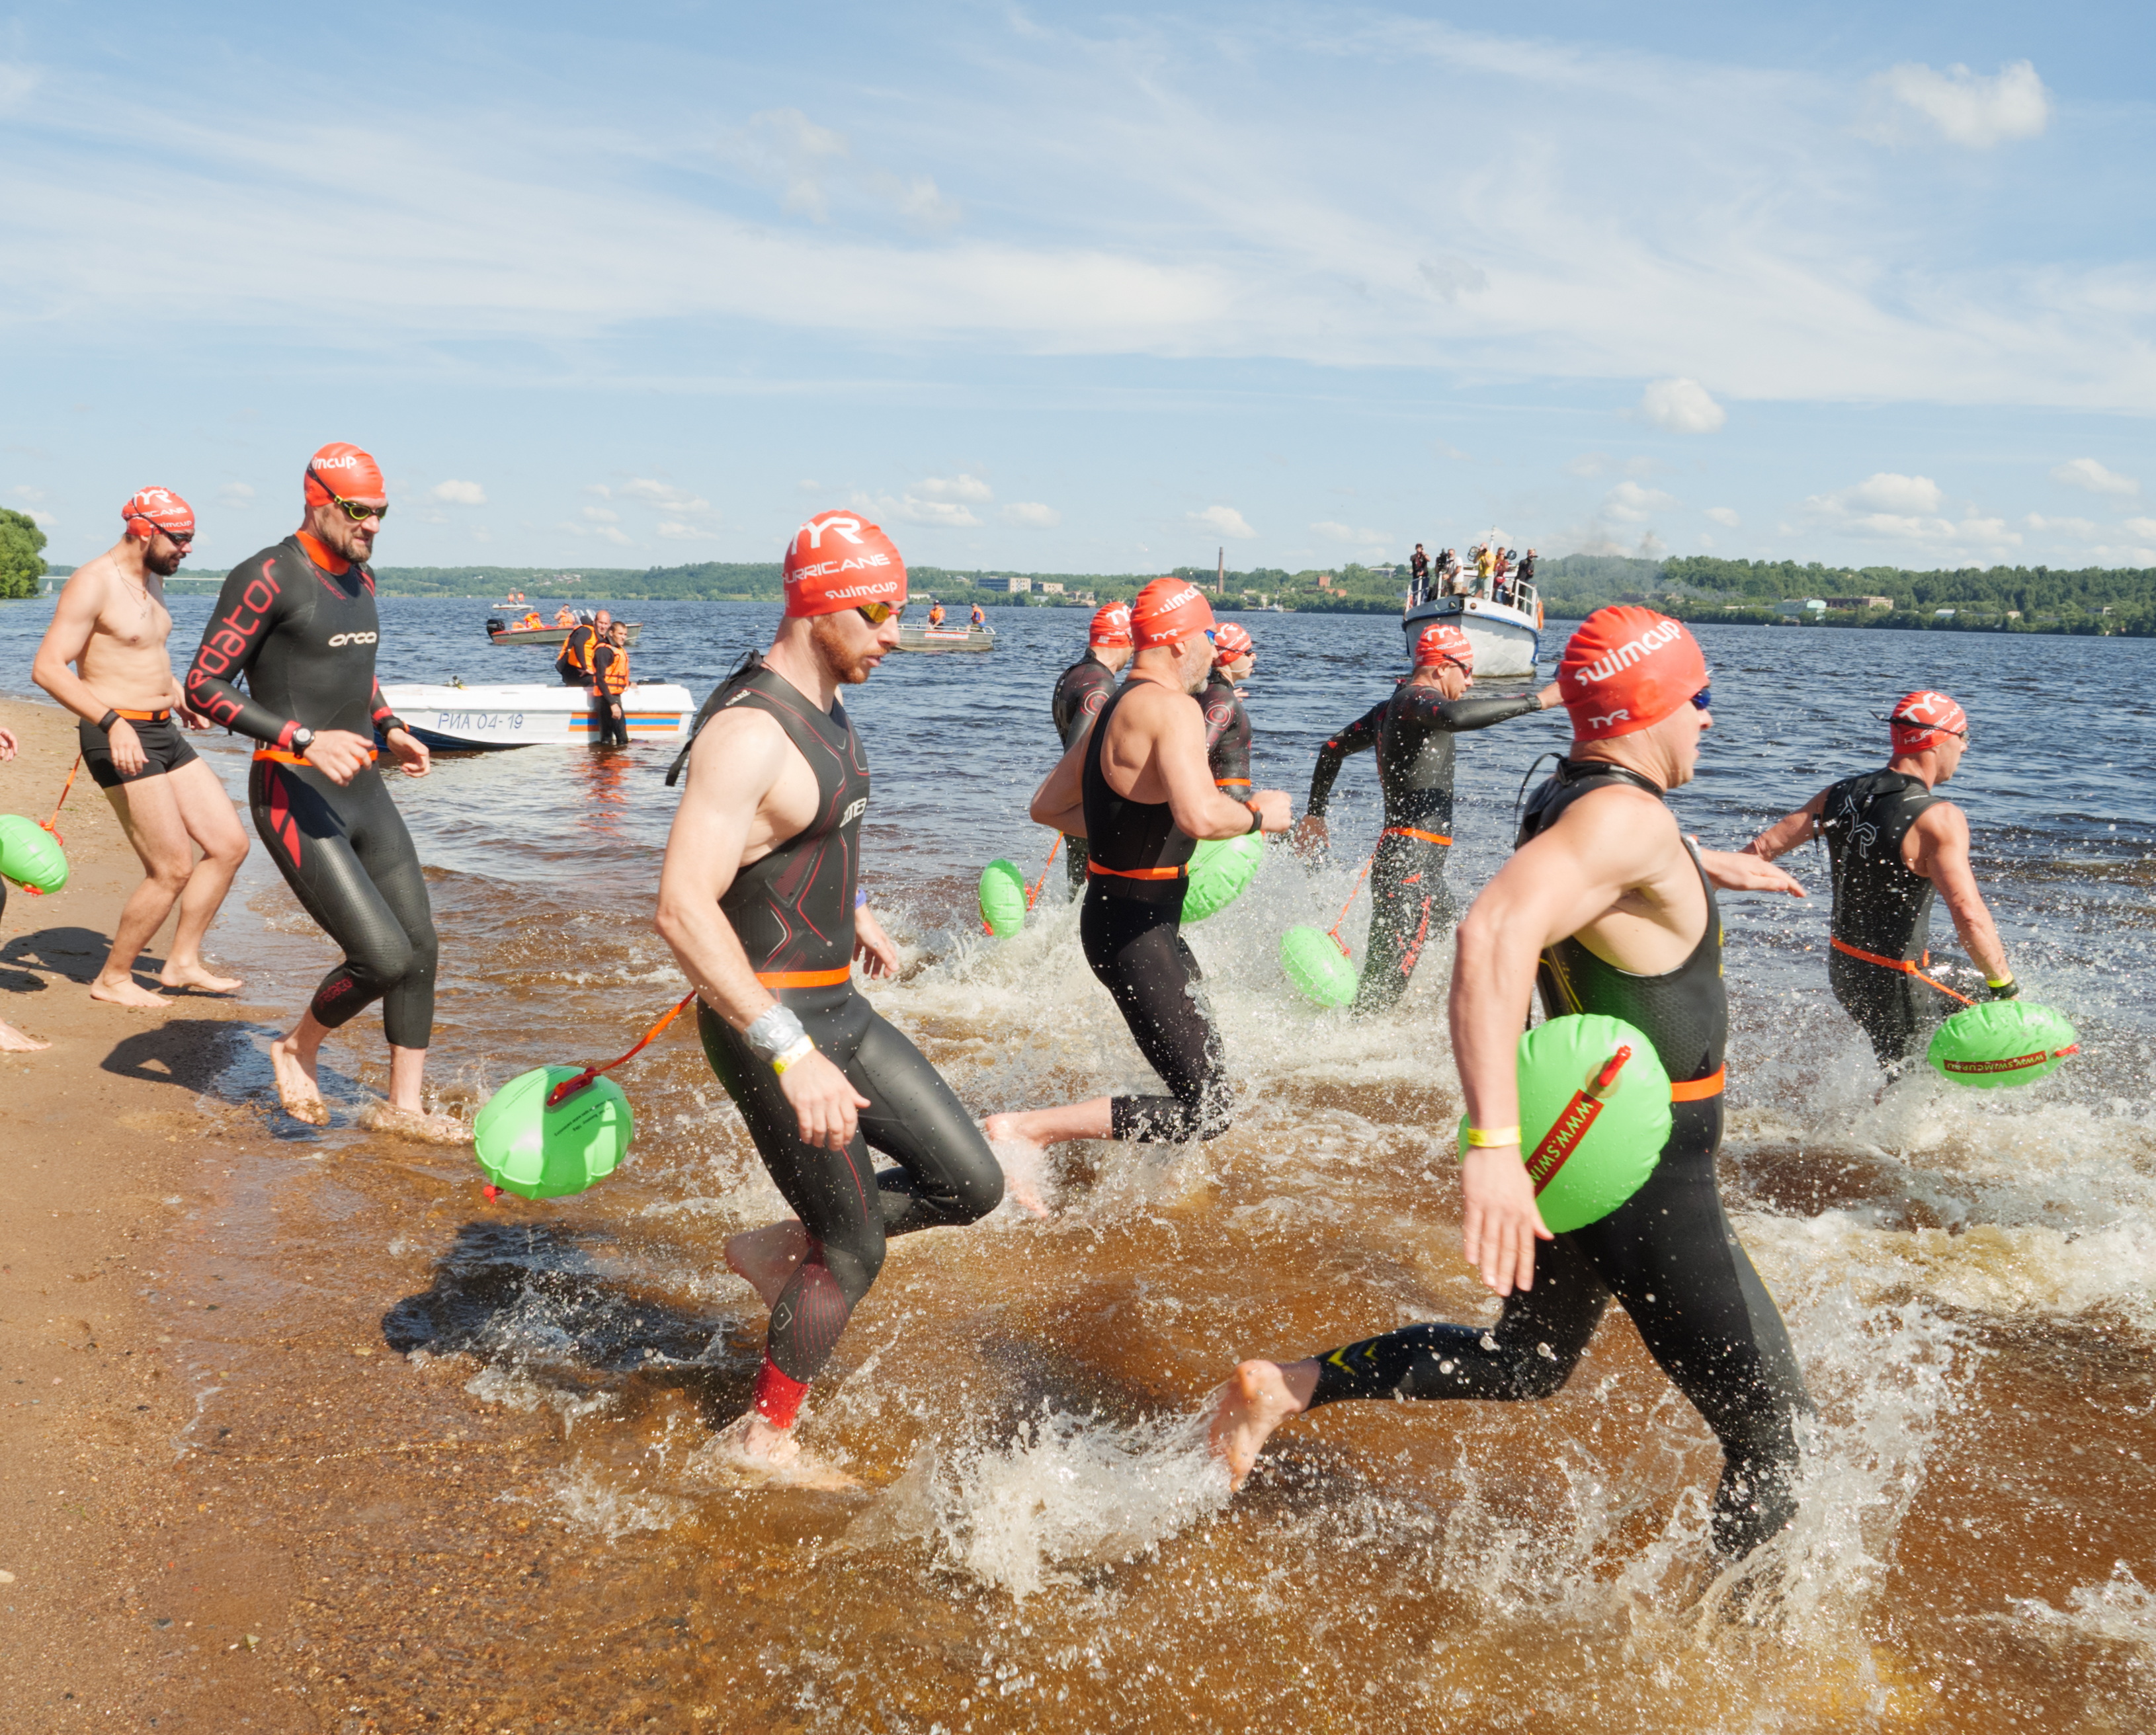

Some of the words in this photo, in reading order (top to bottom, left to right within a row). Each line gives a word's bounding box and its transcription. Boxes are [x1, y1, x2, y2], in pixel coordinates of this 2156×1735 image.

[791, 517, 864, 555] TYR
[824, 581, 898, 600] swimcup
[1105, 605, 1132, 625] TY
[328, 631, 378, 647] orca
[1150, 629, 1178, 641] TYR
[1574, 620, 1682, 686] swimcup
[1899, 692, 1949, 723] TYR
[1588, 709, 1632, 729] TYR
